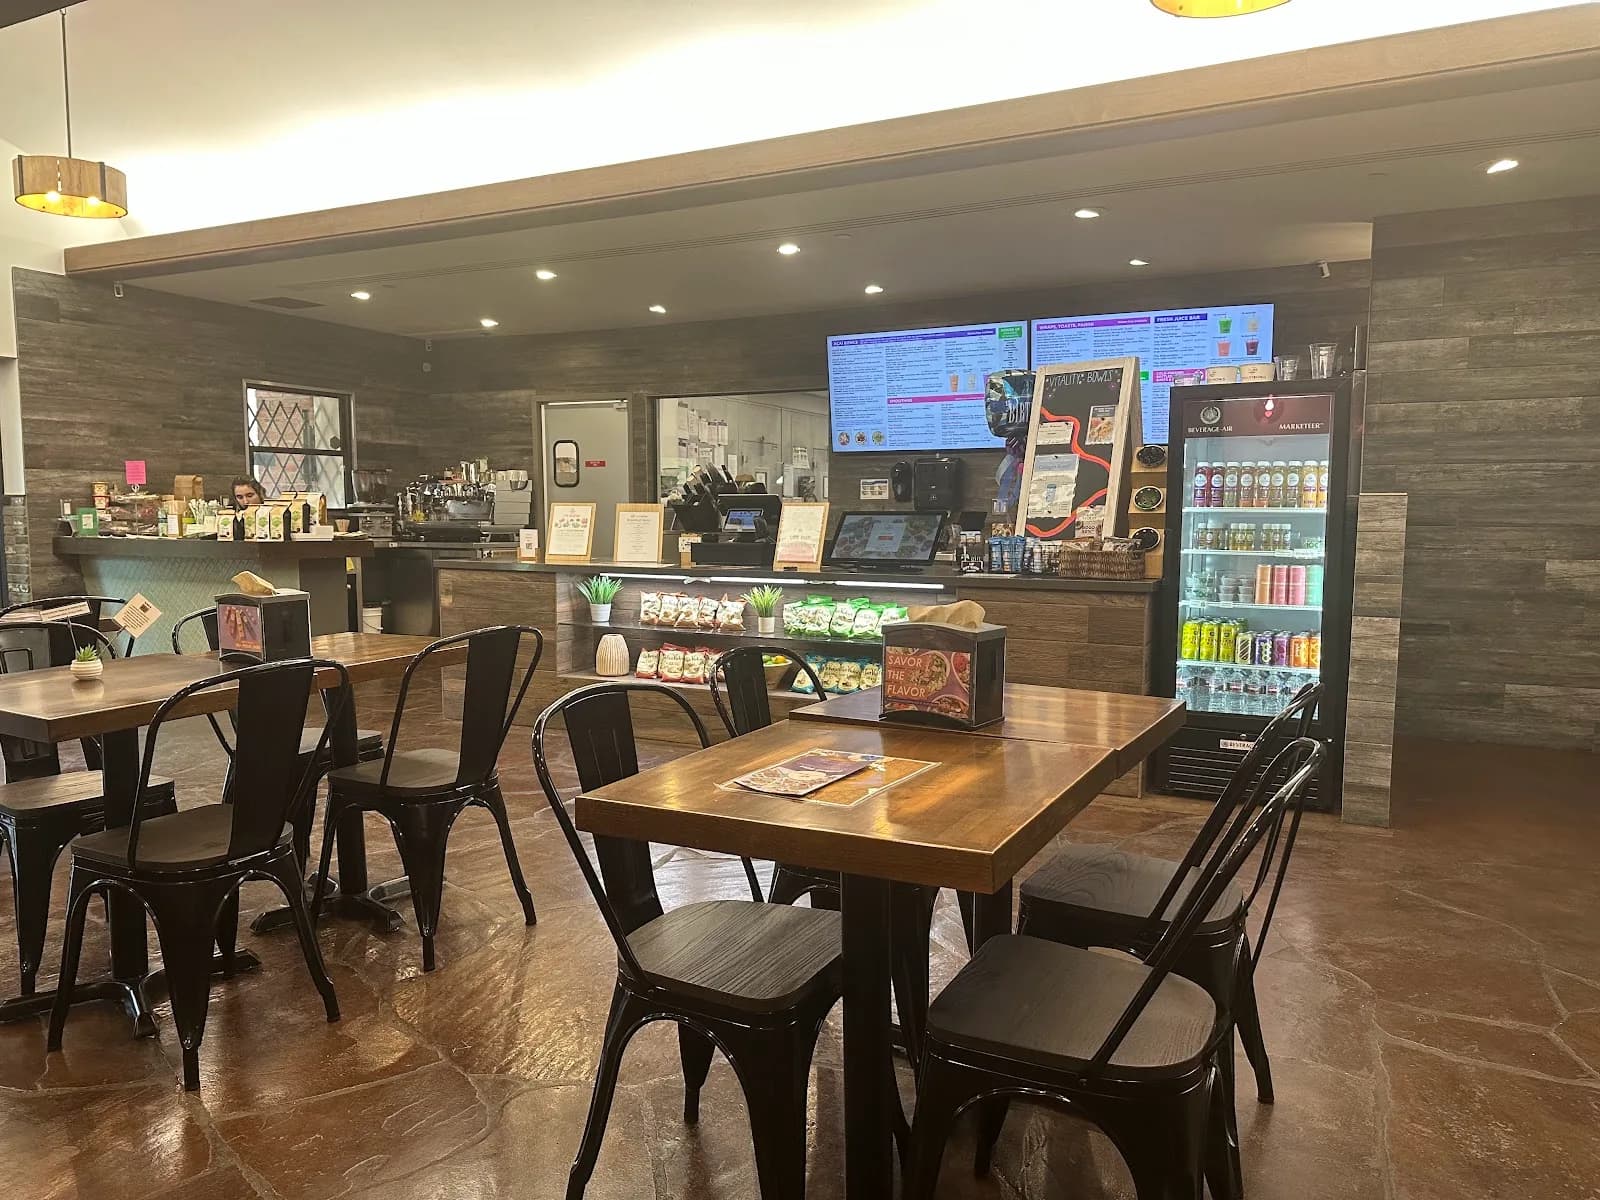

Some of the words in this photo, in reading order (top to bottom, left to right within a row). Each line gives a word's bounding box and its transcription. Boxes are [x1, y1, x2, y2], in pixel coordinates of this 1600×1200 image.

[1049, 373, 1080, 387] VITALITY
[1087, 370, 1114, 383] BOWLS
[1187, 425, 1233, 433] BEVERAGE-AIR
[888, 655, 922, 667] SAVOR
[887, 669, 905, 681] THE
[887, 684, 926, 698] FLAVOR
